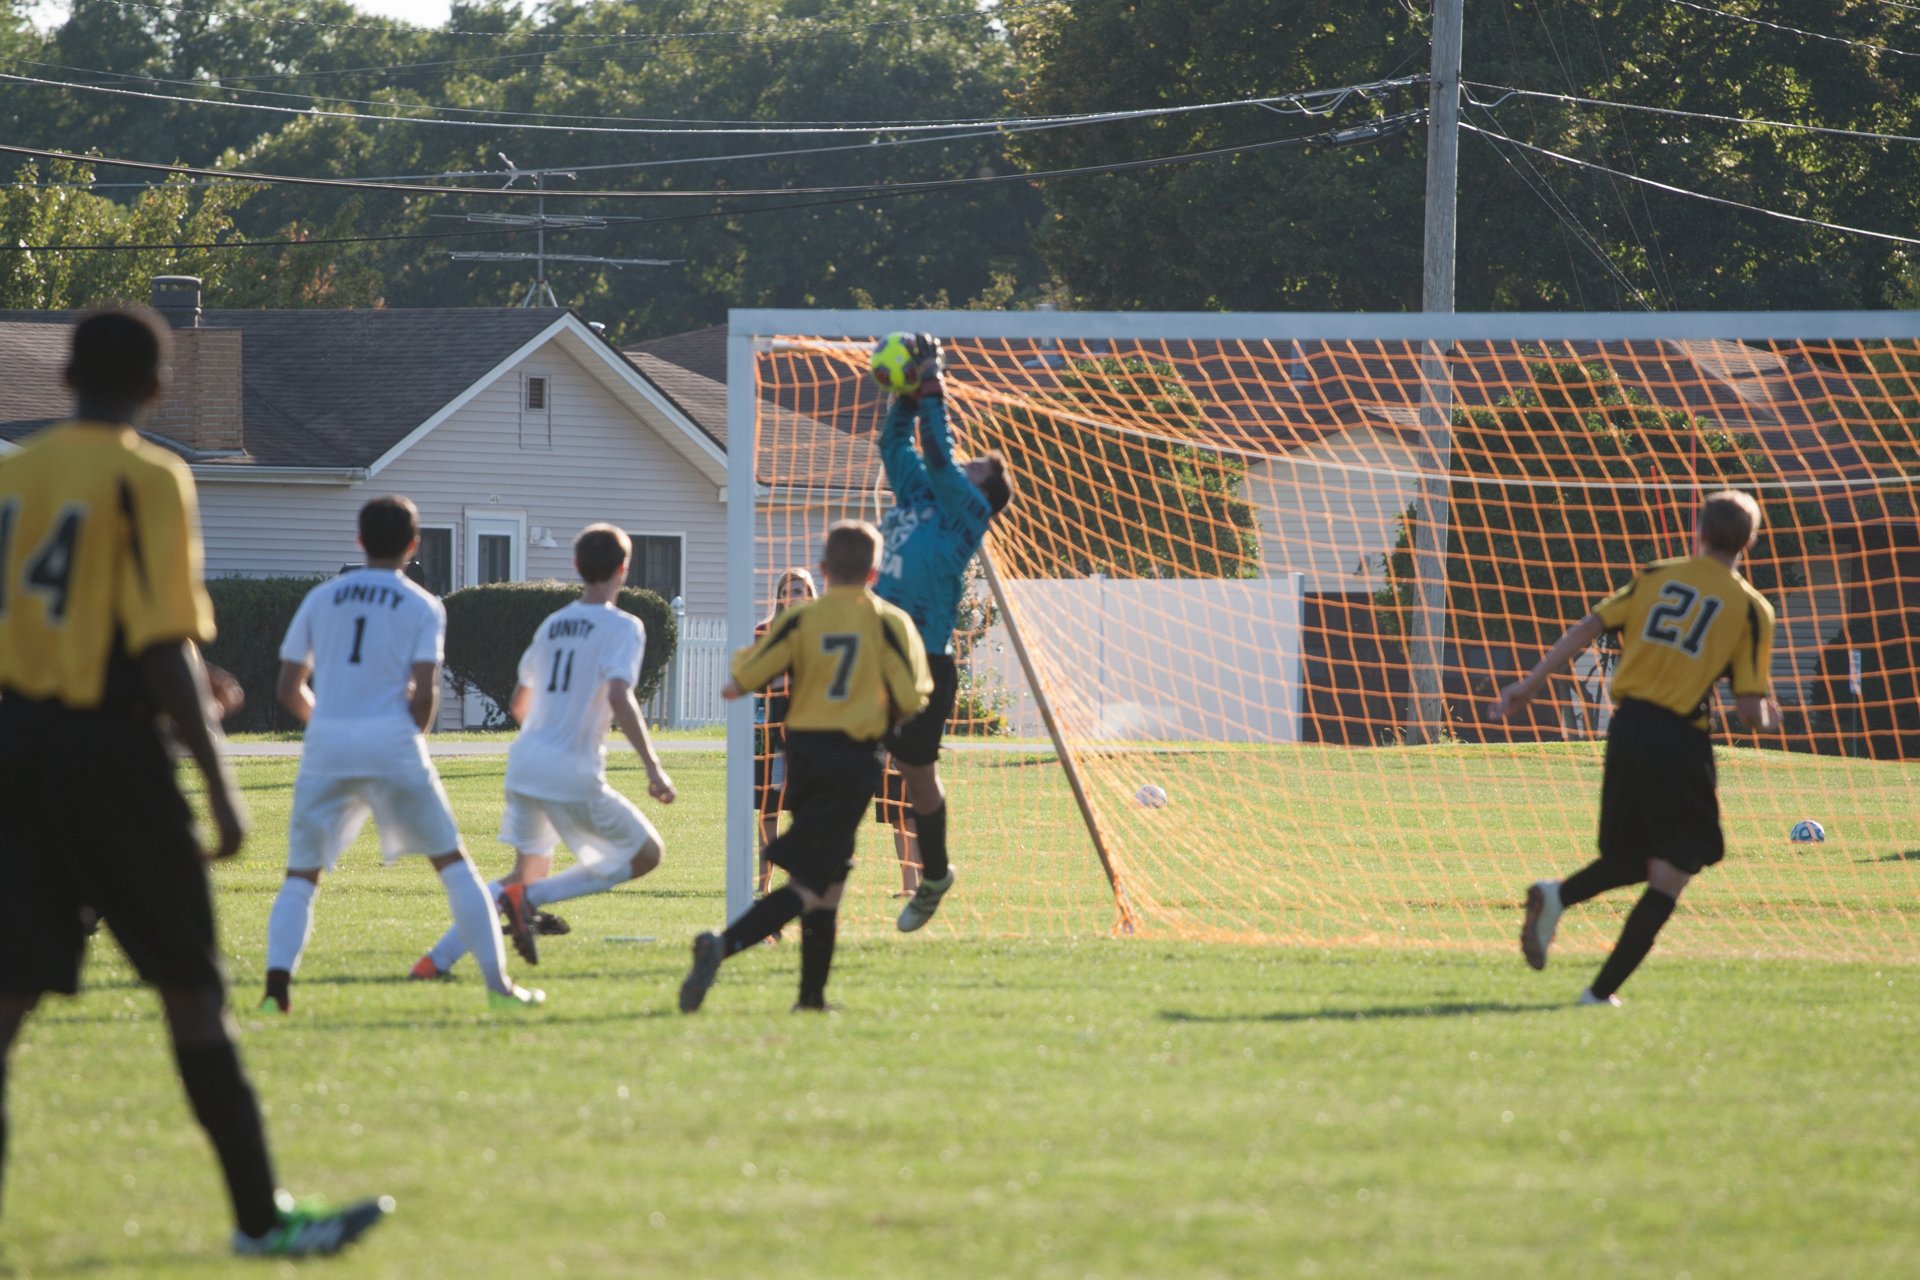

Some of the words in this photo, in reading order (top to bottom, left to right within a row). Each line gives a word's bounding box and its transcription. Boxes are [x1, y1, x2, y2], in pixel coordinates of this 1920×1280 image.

[333, 584, 404, 611] UNITY
[1643, 579, 1724, 659] 21
[348, 615, 367, 664] 1
[548, 618, 596, 640] UNITY
[547, 648, 575, 692] 11
[821, 632, 861, 701] 7
